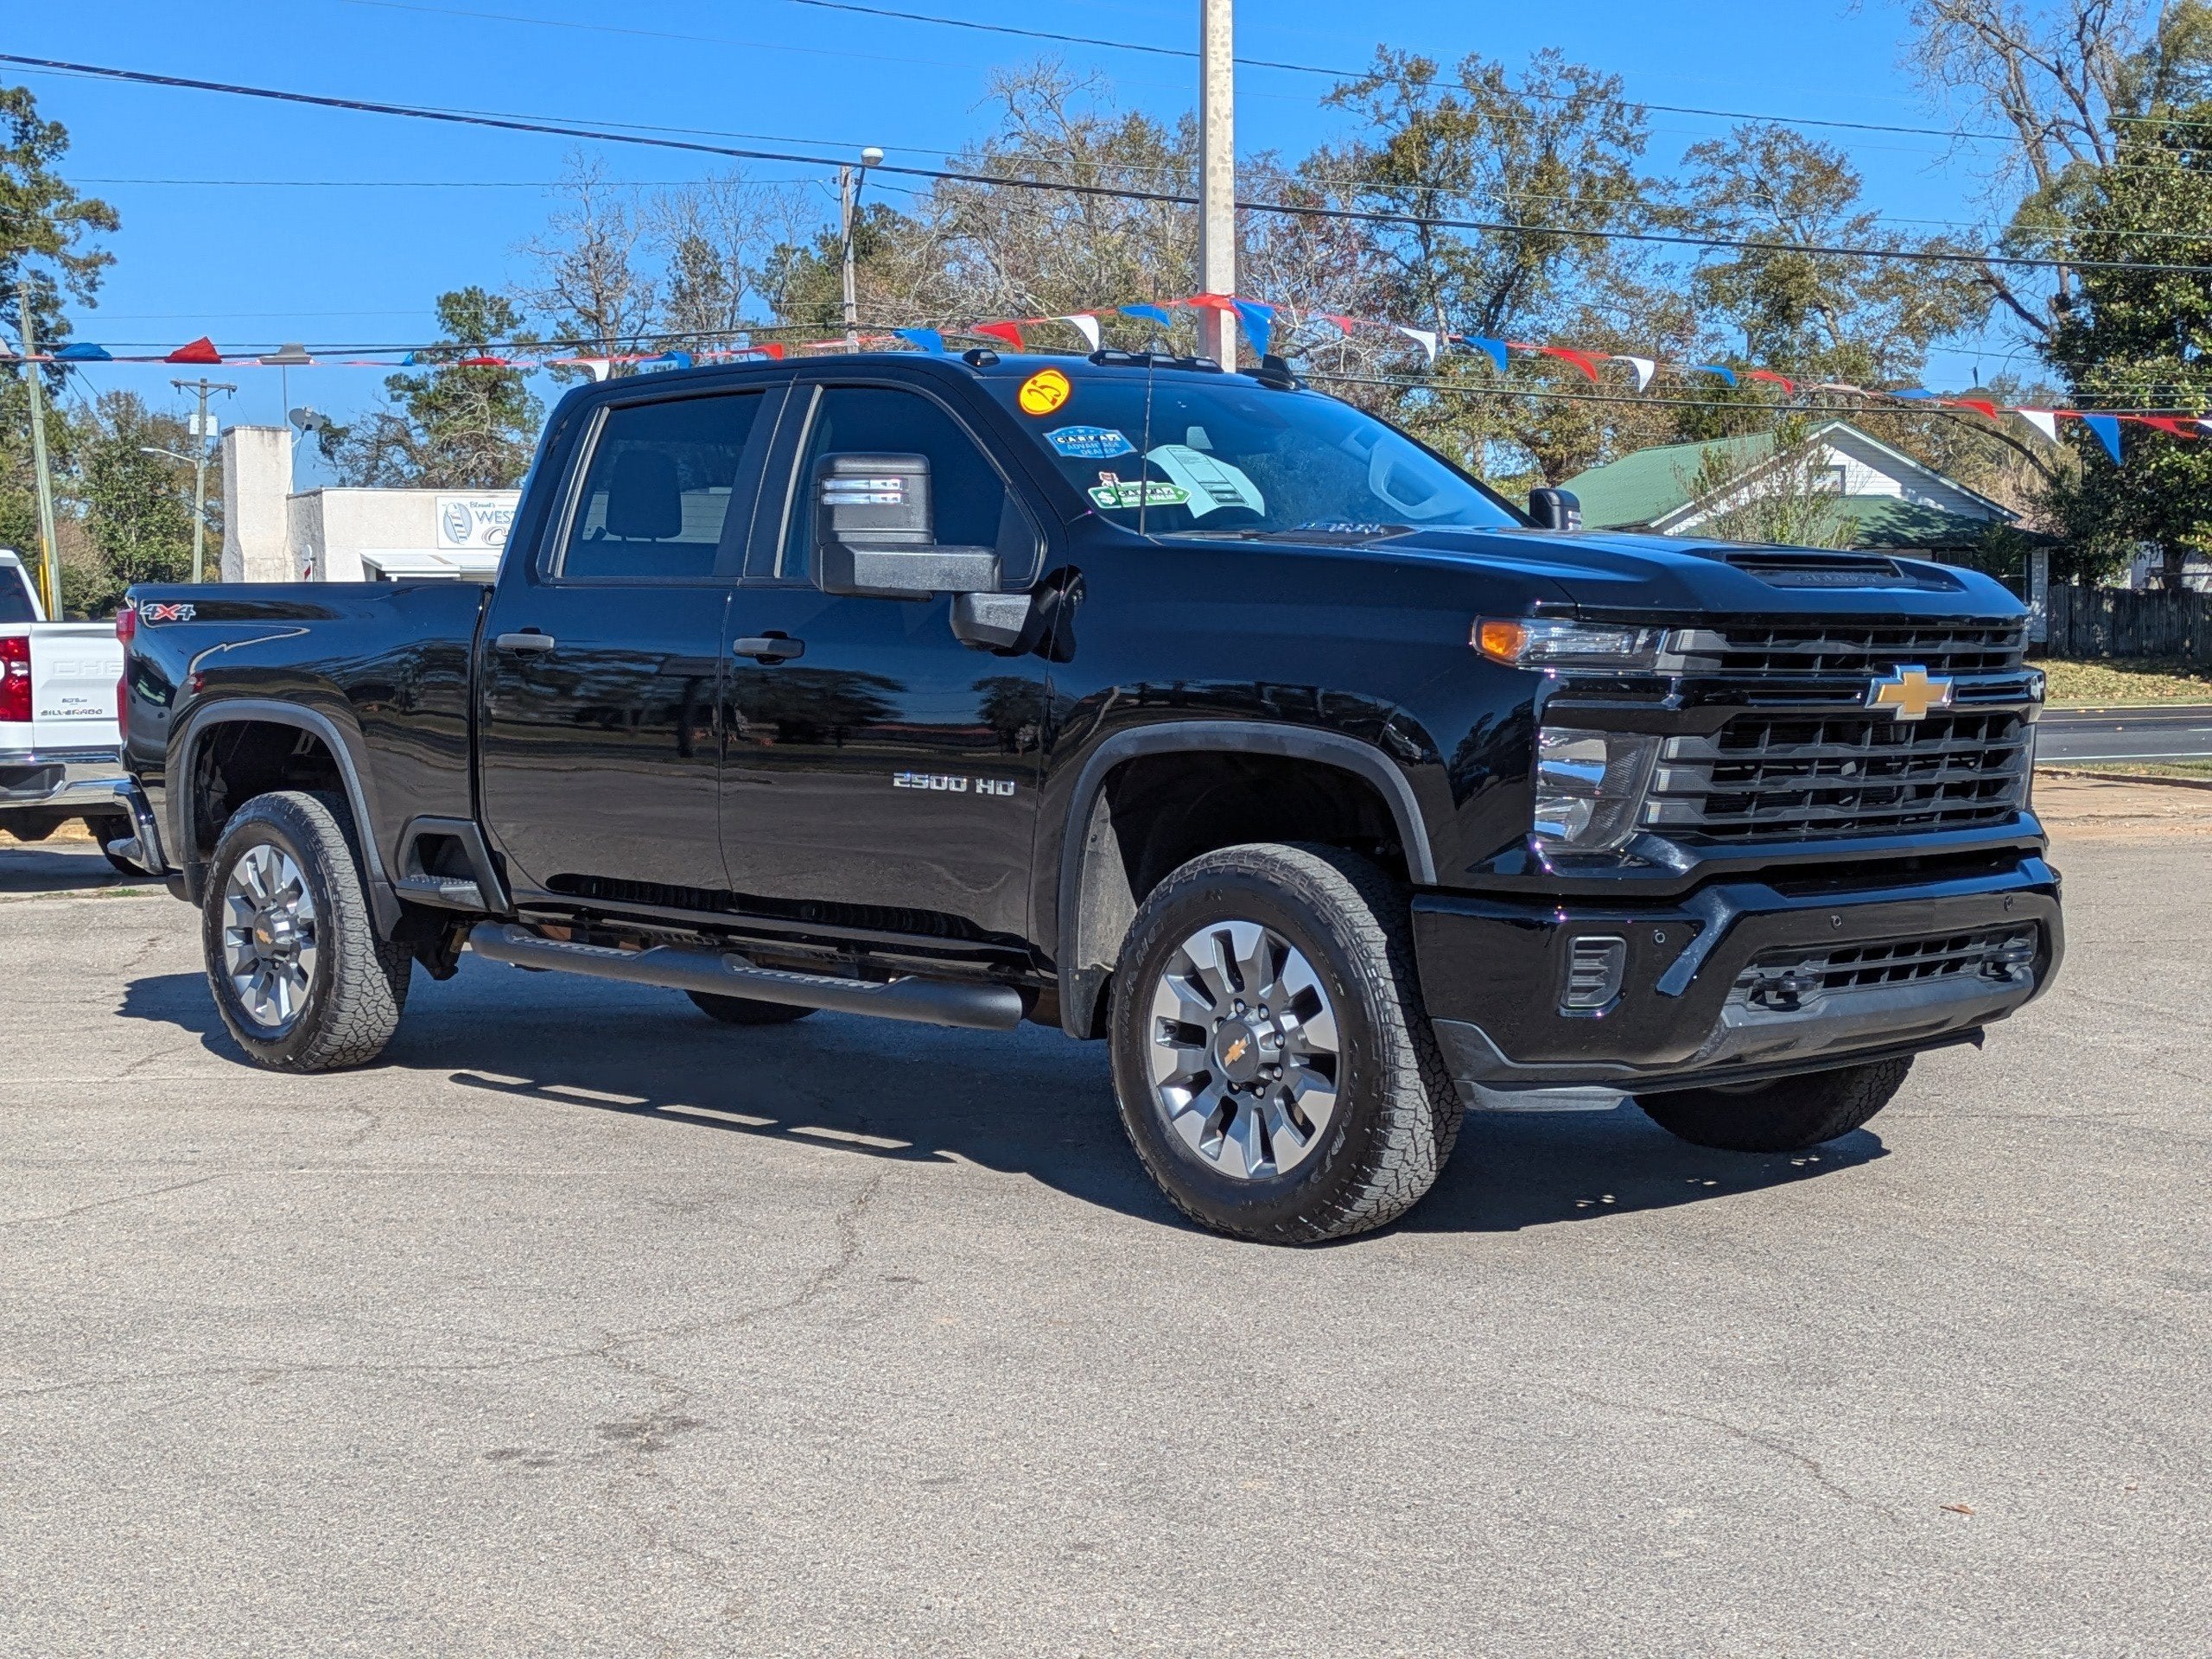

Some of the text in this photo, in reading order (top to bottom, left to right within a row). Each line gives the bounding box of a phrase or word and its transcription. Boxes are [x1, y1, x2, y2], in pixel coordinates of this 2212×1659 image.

[1027, 378, 1062, 407] 25
[1055, 433, 1121, 443] CARFAX
[1067, 442, 1122, 450] ADVANAGE
[893, 772, 1014, 796] 2500 HD
